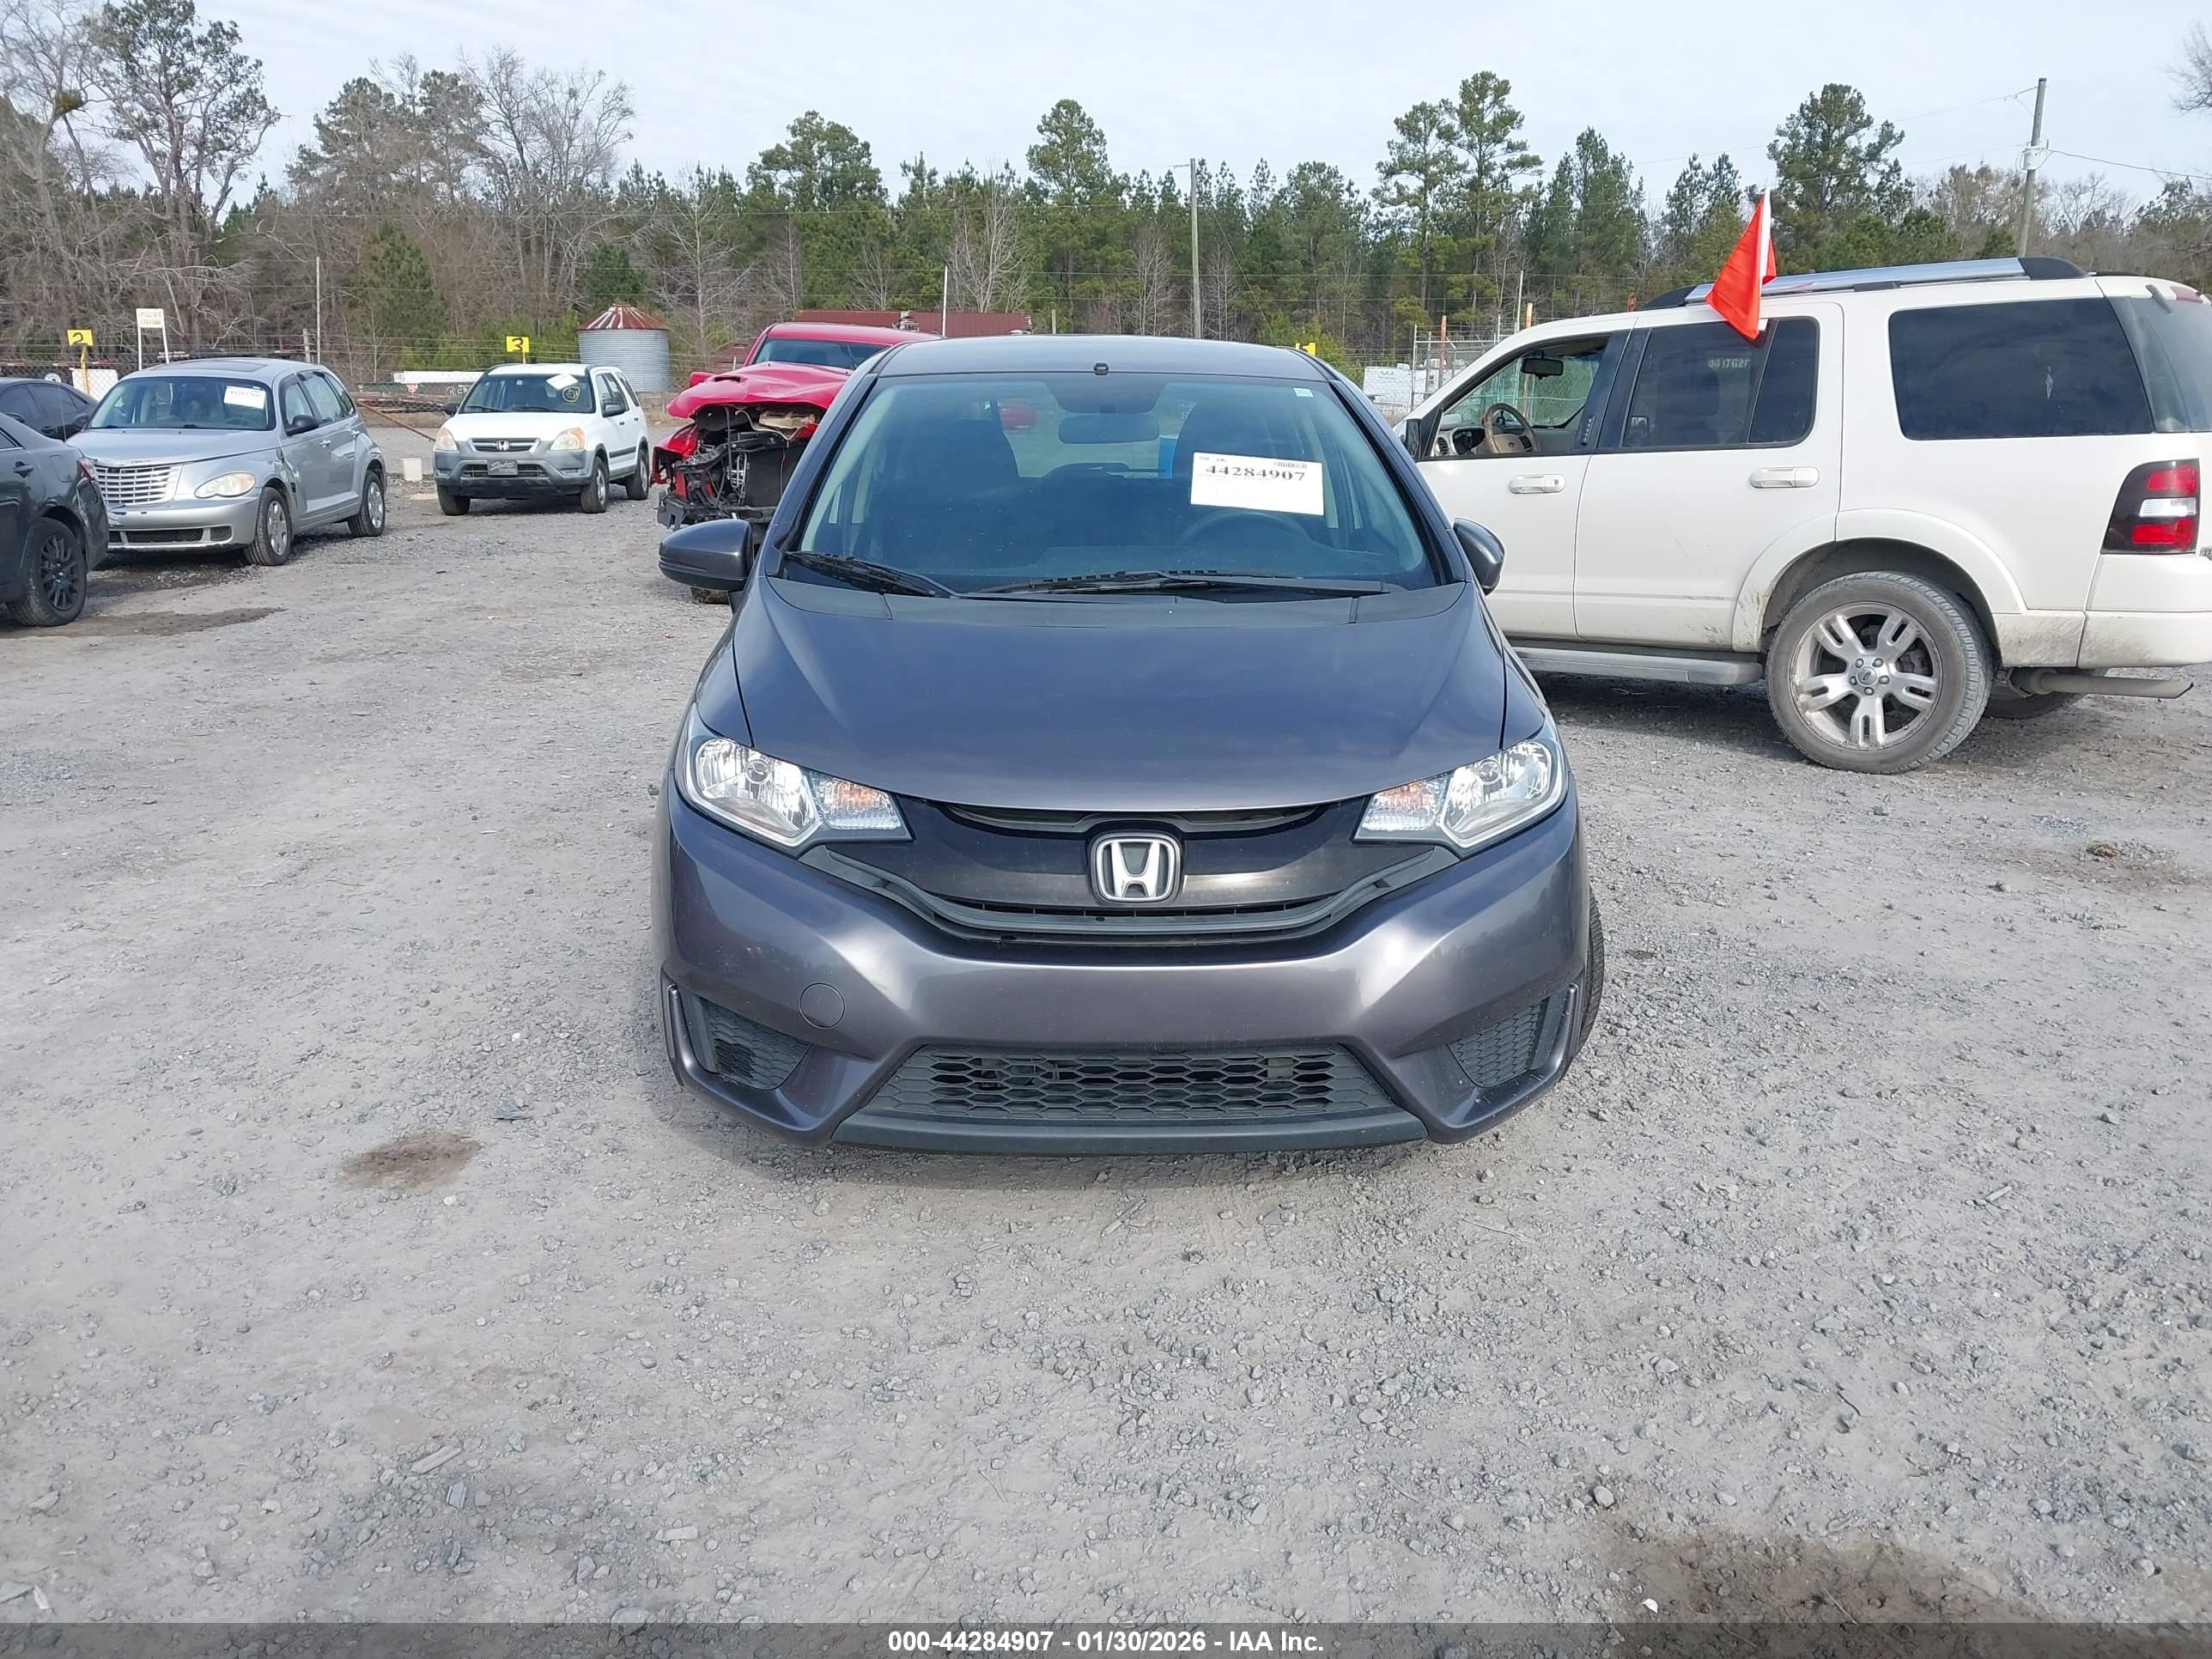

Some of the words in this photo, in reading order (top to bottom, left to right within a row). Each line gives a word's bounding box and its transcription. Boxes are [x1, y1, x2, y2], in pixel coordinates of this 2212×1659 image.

[70, 331, 88, 346] 2
[512, 337, 524, 352] 3
[1205, 465, 1306, 482] 44284907
